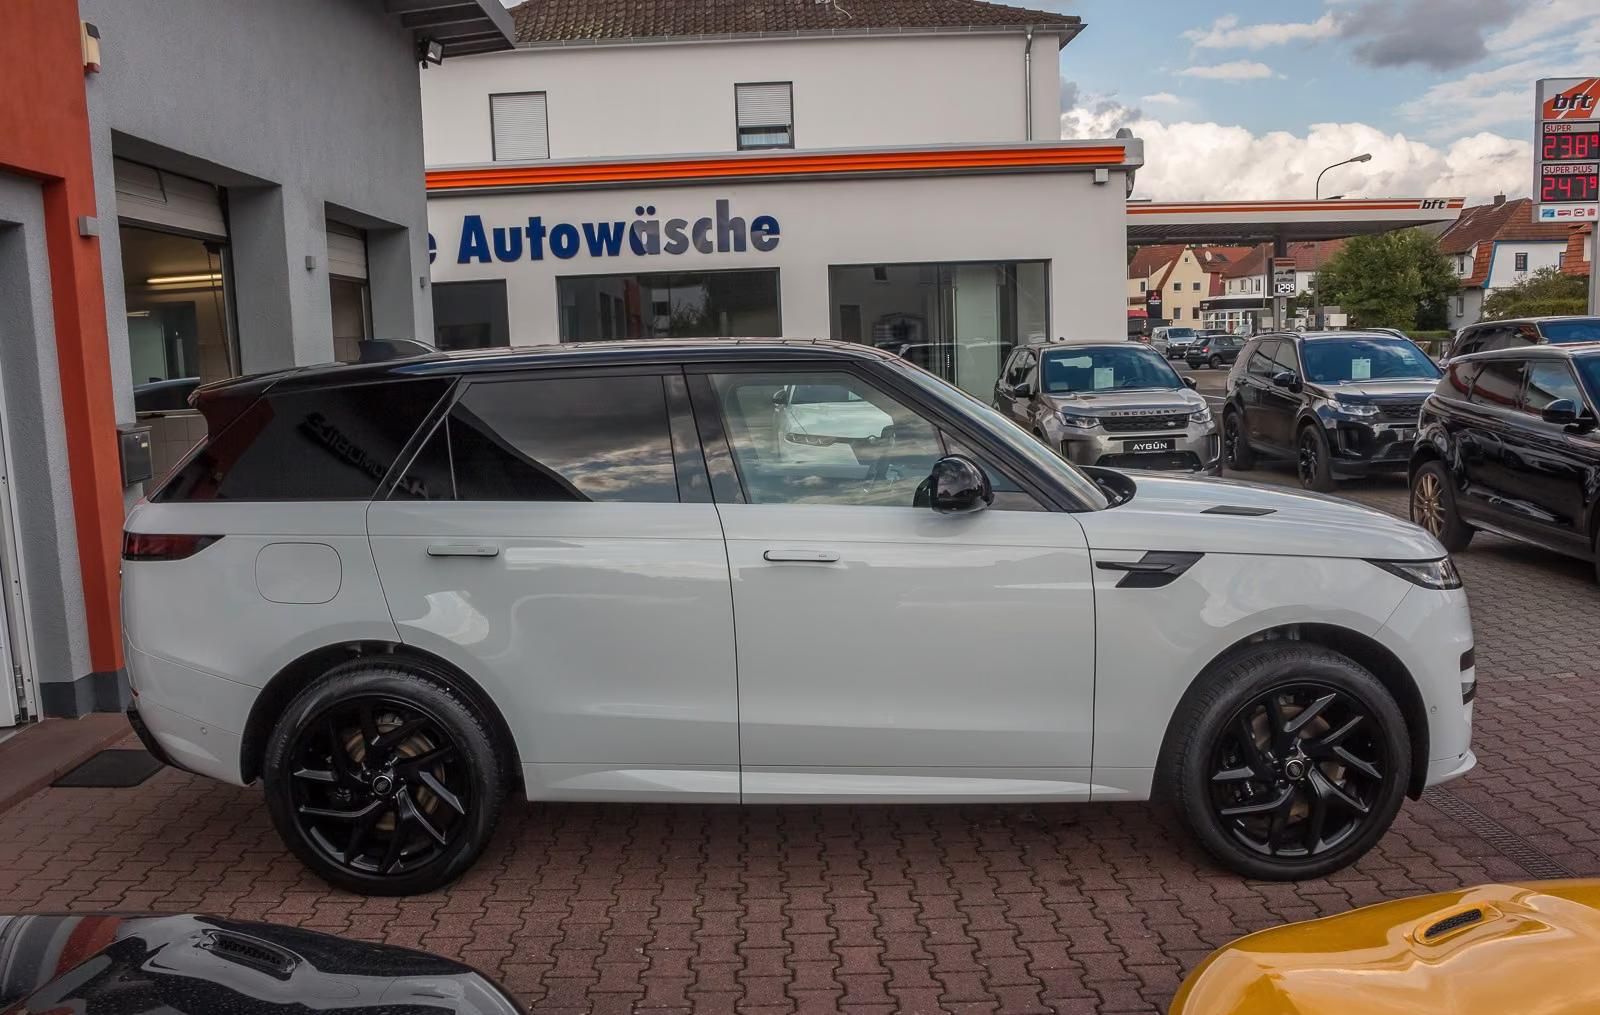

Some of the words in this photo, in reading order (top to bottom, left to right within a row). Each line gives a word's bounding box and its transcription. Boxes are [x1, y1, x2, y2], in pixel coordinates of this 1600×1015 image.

[1552, 93, 1594, 111] bft
[1545, 124, 1572, 133] SUPER
[1544, 165, 1570, 174] SUPER
[1572, 165, 1593, 174] PLUS
[1422, 199, 1446, 209] bft
[457, 199, 781, 264] Autowäsche
[1133, 441, 1168, 450] AYGÜN
